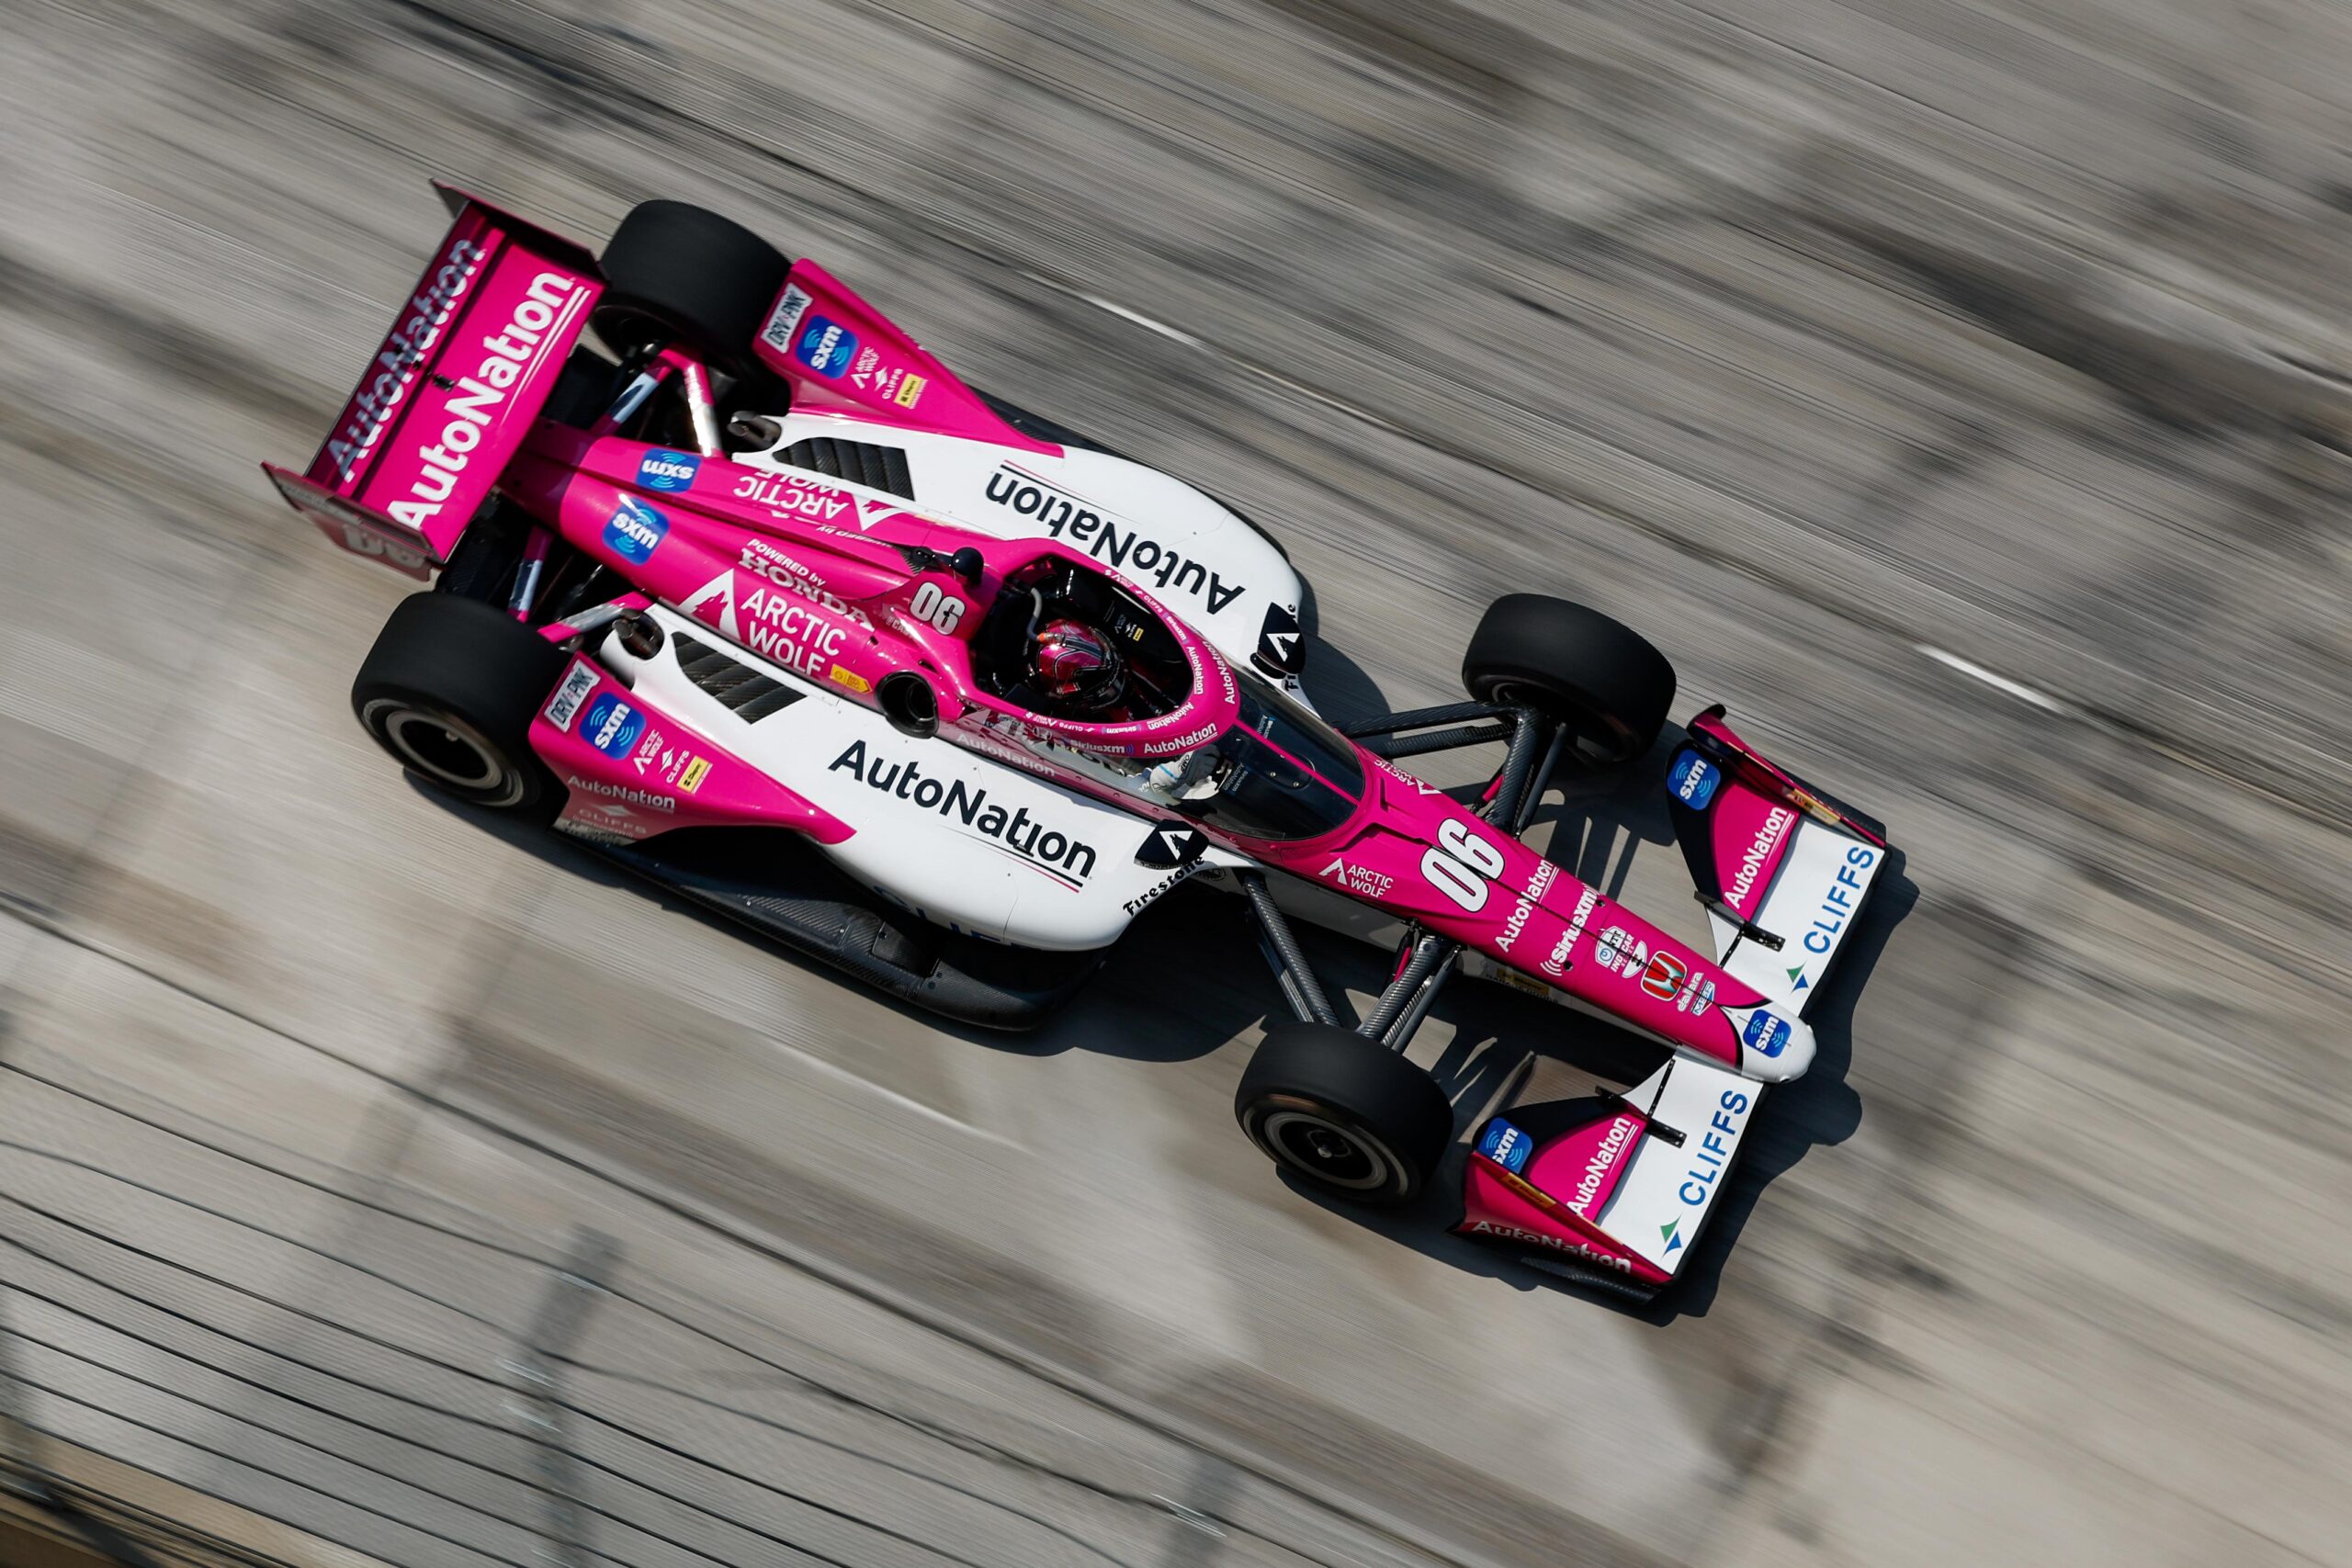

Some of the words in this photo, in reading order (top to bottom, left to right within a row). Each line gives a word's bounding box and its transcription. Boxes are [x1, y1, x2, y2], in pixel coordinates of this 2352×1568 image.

[328, 240, 487, 483] AutoNation
[810, 325, 842, 370] sxm
[387, 273, 574, 529] AutoNation
[642, 458, 695, 480] sxm
[733, 475, 850, 521] ARCTIC
[612, 513, 659, 549] sxm
[986, 472, 1246, 615] AutoNation
[746, 538, 808, 577] POWERED
[808, 570, 826, 588] by
[737, 547, 876, 632] HONDA
[909, 581, 967, 636] 06
[741, 588, 846, 657] ARCTIC
[748, 621, 826, 677] WOLF
[1187, 645, 1204, 695] AutoNation
[1203, 640, 1236, 705] AutoNation
[594, 703, 631, 750] sxm
[1144, 723, 1217, 754] AutoNation
[1148, 702, 1194, 730] AutoNation
[665, 750, 690, 784] CLIFFS
[956, 735, 1055, 777] AutoNation
[1374, 760, 1415, 786] ARCTIC
[1679, 759, 1707, 799] sxm
[568, 775, 675, 809] AutoNation
[829, 739, 1097, 878] AutoNation
[1347, 864, 1394, 889] ARCTIC
[1420, 817, 1505, 913] 06
[1724, 807, 1787, 908] AutoNation
[1122, 855, 1205, 918] Firestone
[1351, 878, 1385, 898] WOLF
[1495, 859, 1554, 953] AutoNation
[1804, 846, 1874, 953] CLIFFS
[1756, 1016, 1780, 1051] sxm
[1567, 1116, 1632, 1217] AutoNation
[1679, 1090, 1748, 1206] CLIFFS
[1473, 1220, 1632, 1273] AutoNation
